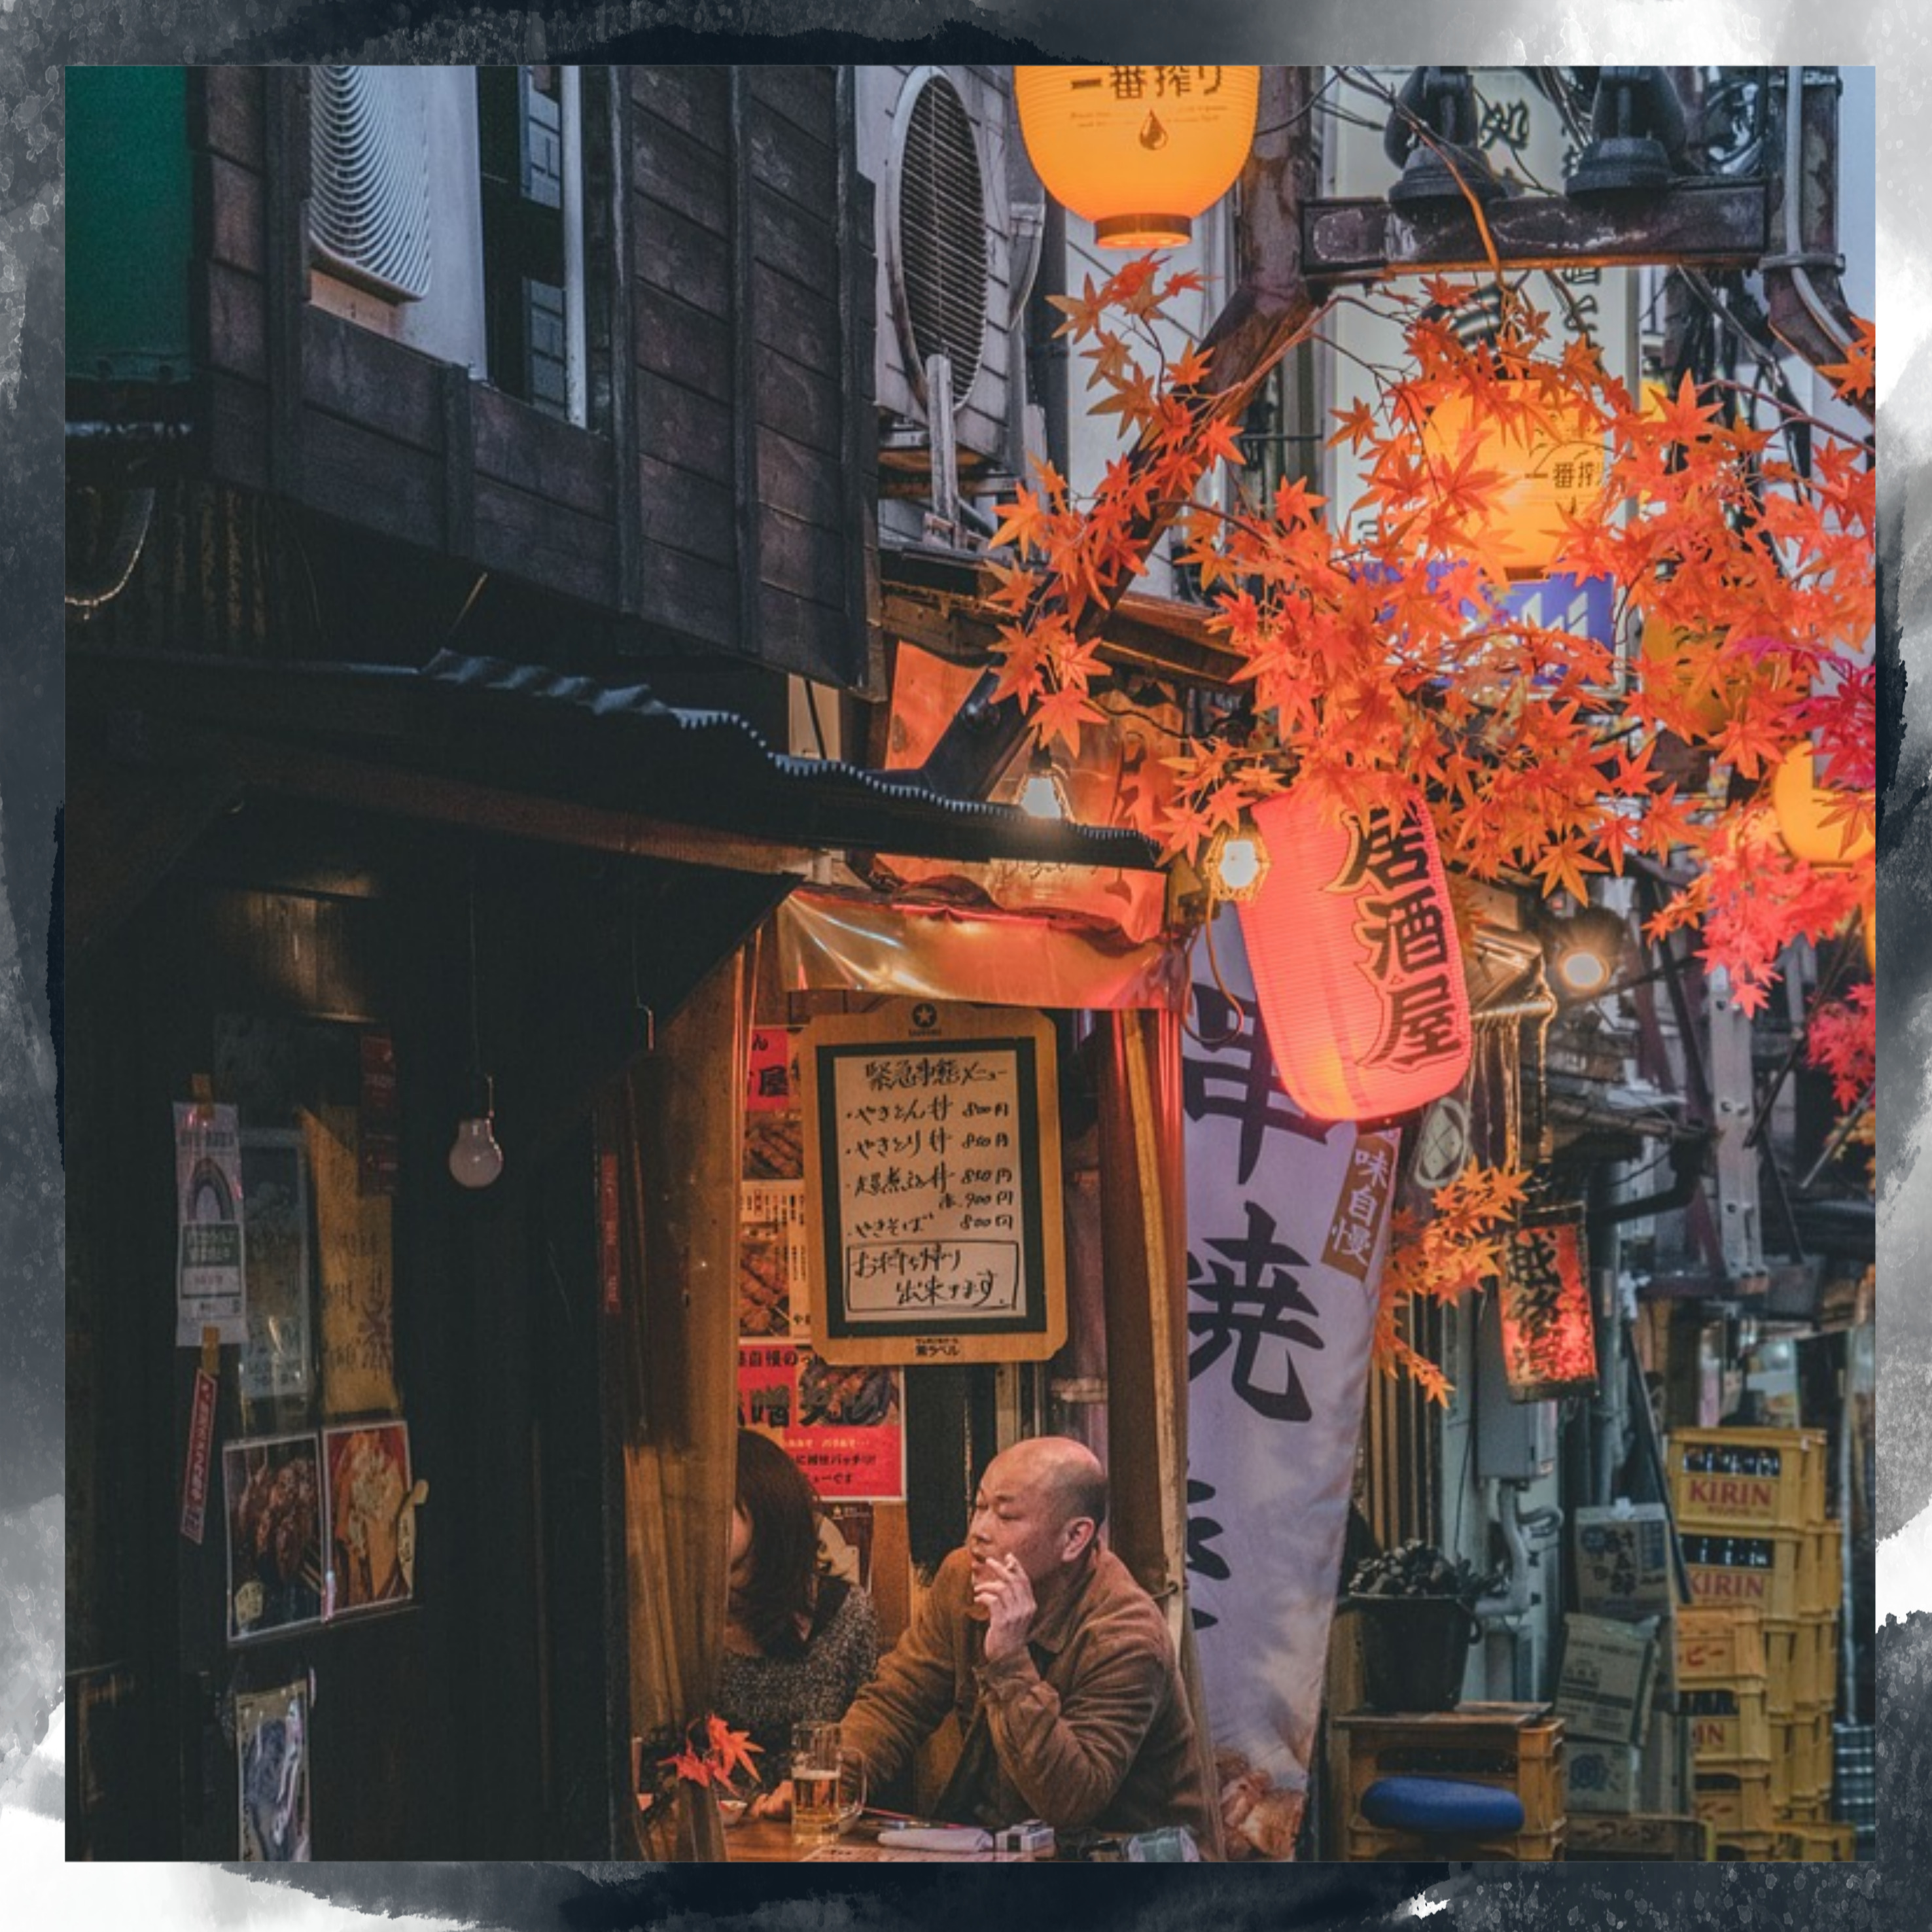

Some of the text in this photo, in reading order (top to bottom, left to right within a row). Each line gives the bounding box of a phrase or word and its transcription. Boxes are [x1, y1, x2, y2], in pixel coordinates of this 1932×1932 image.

[1341, 798, 1464, 1067] 居酒屋
[1332, 1148, 1389, 1267] 味自慢
[1689, 1479, 1772, 1506] KIRIN
